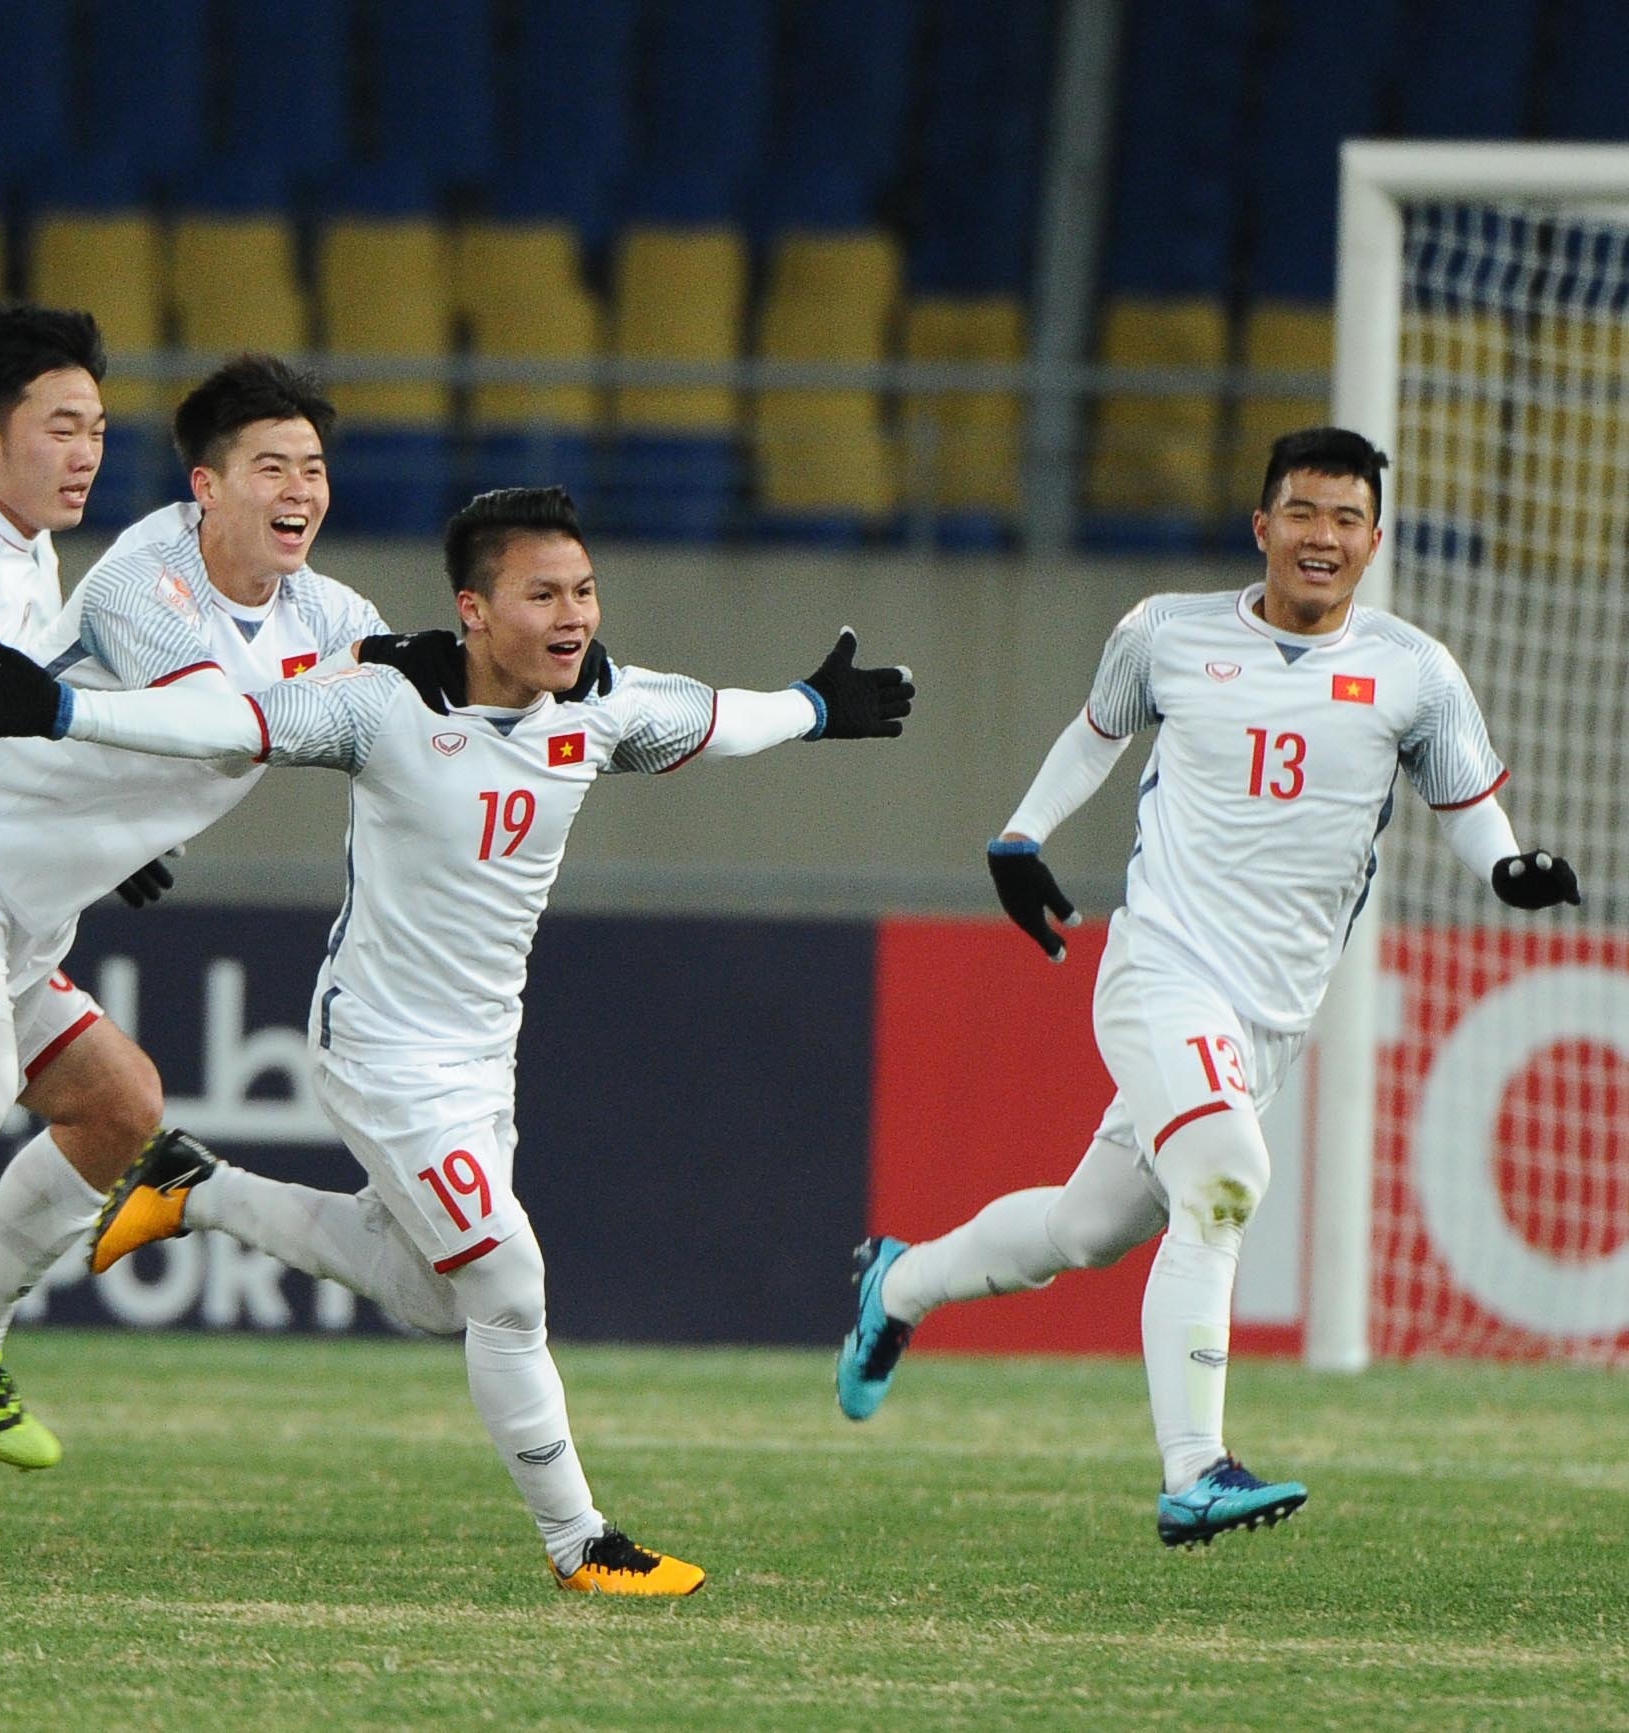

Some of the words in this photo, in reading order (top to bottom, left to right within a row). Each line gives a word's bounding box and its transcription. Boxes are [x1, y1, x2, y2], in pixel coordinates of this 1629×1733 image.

[1246, 728, 1307, 800] 13
[478, 789, 536, 861] 19
[1186, 1034, 1249, 1093] 13
[418, 1149, 495, 1232] 19
